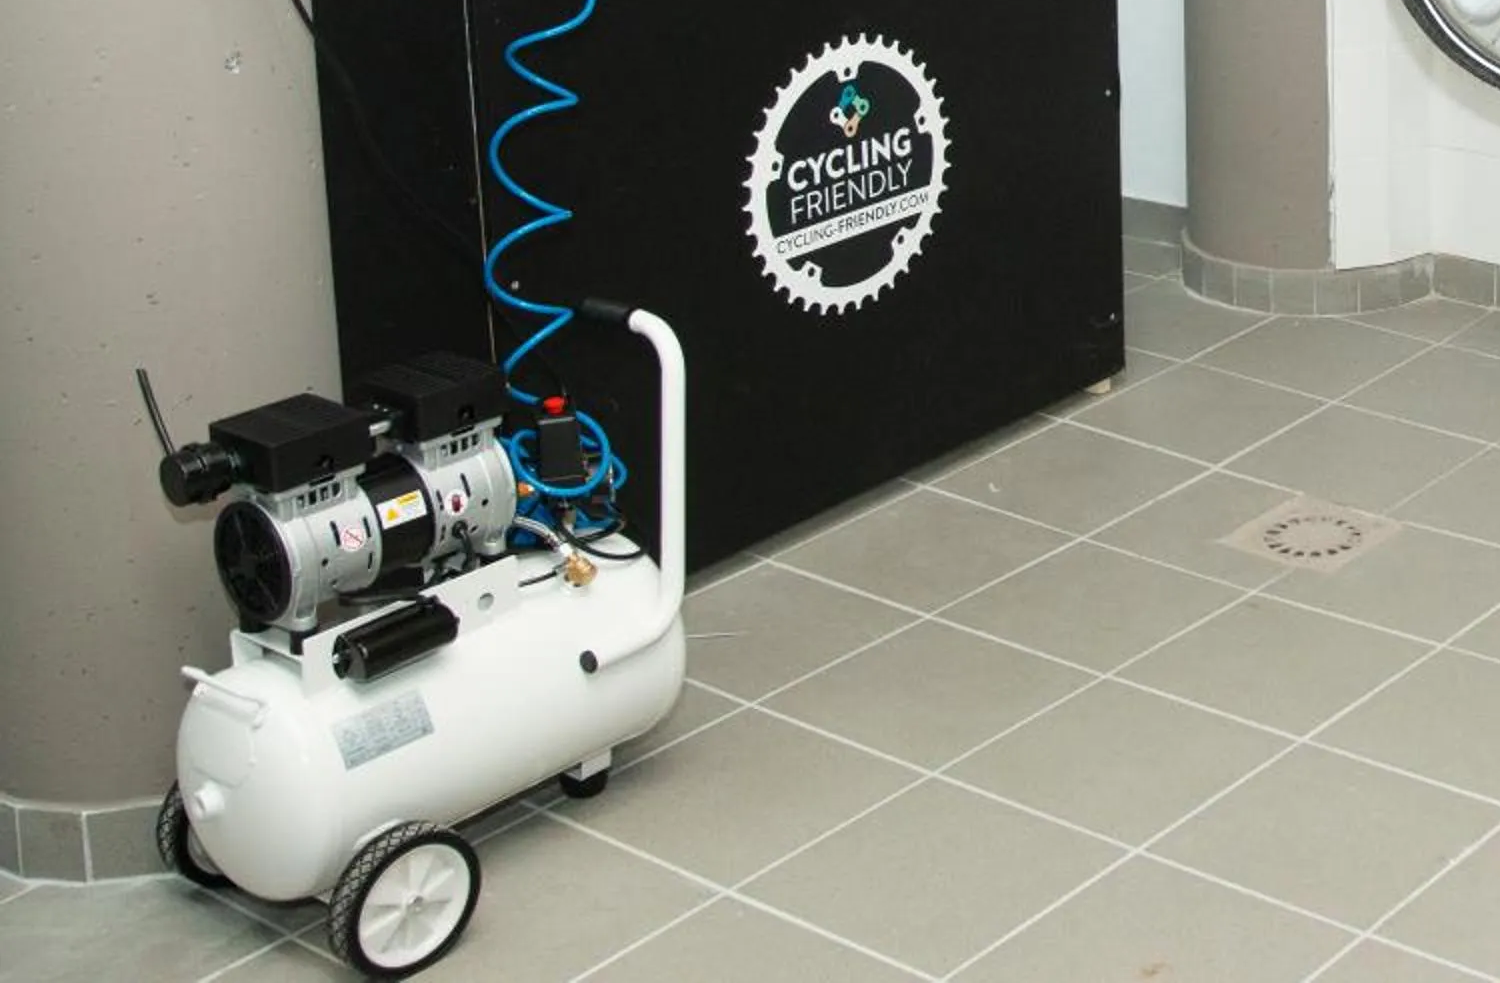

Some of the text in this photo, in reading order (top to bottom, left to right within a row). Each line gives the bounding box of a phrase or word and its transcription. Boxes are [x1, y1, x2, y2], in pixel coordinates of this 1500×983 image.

[787, 127, 912, 192] CYCLING
[790, 158, 913, 225] FRIENDLY
[775, 191, 930, 255] CYCLING-FRIENDLY.COM
